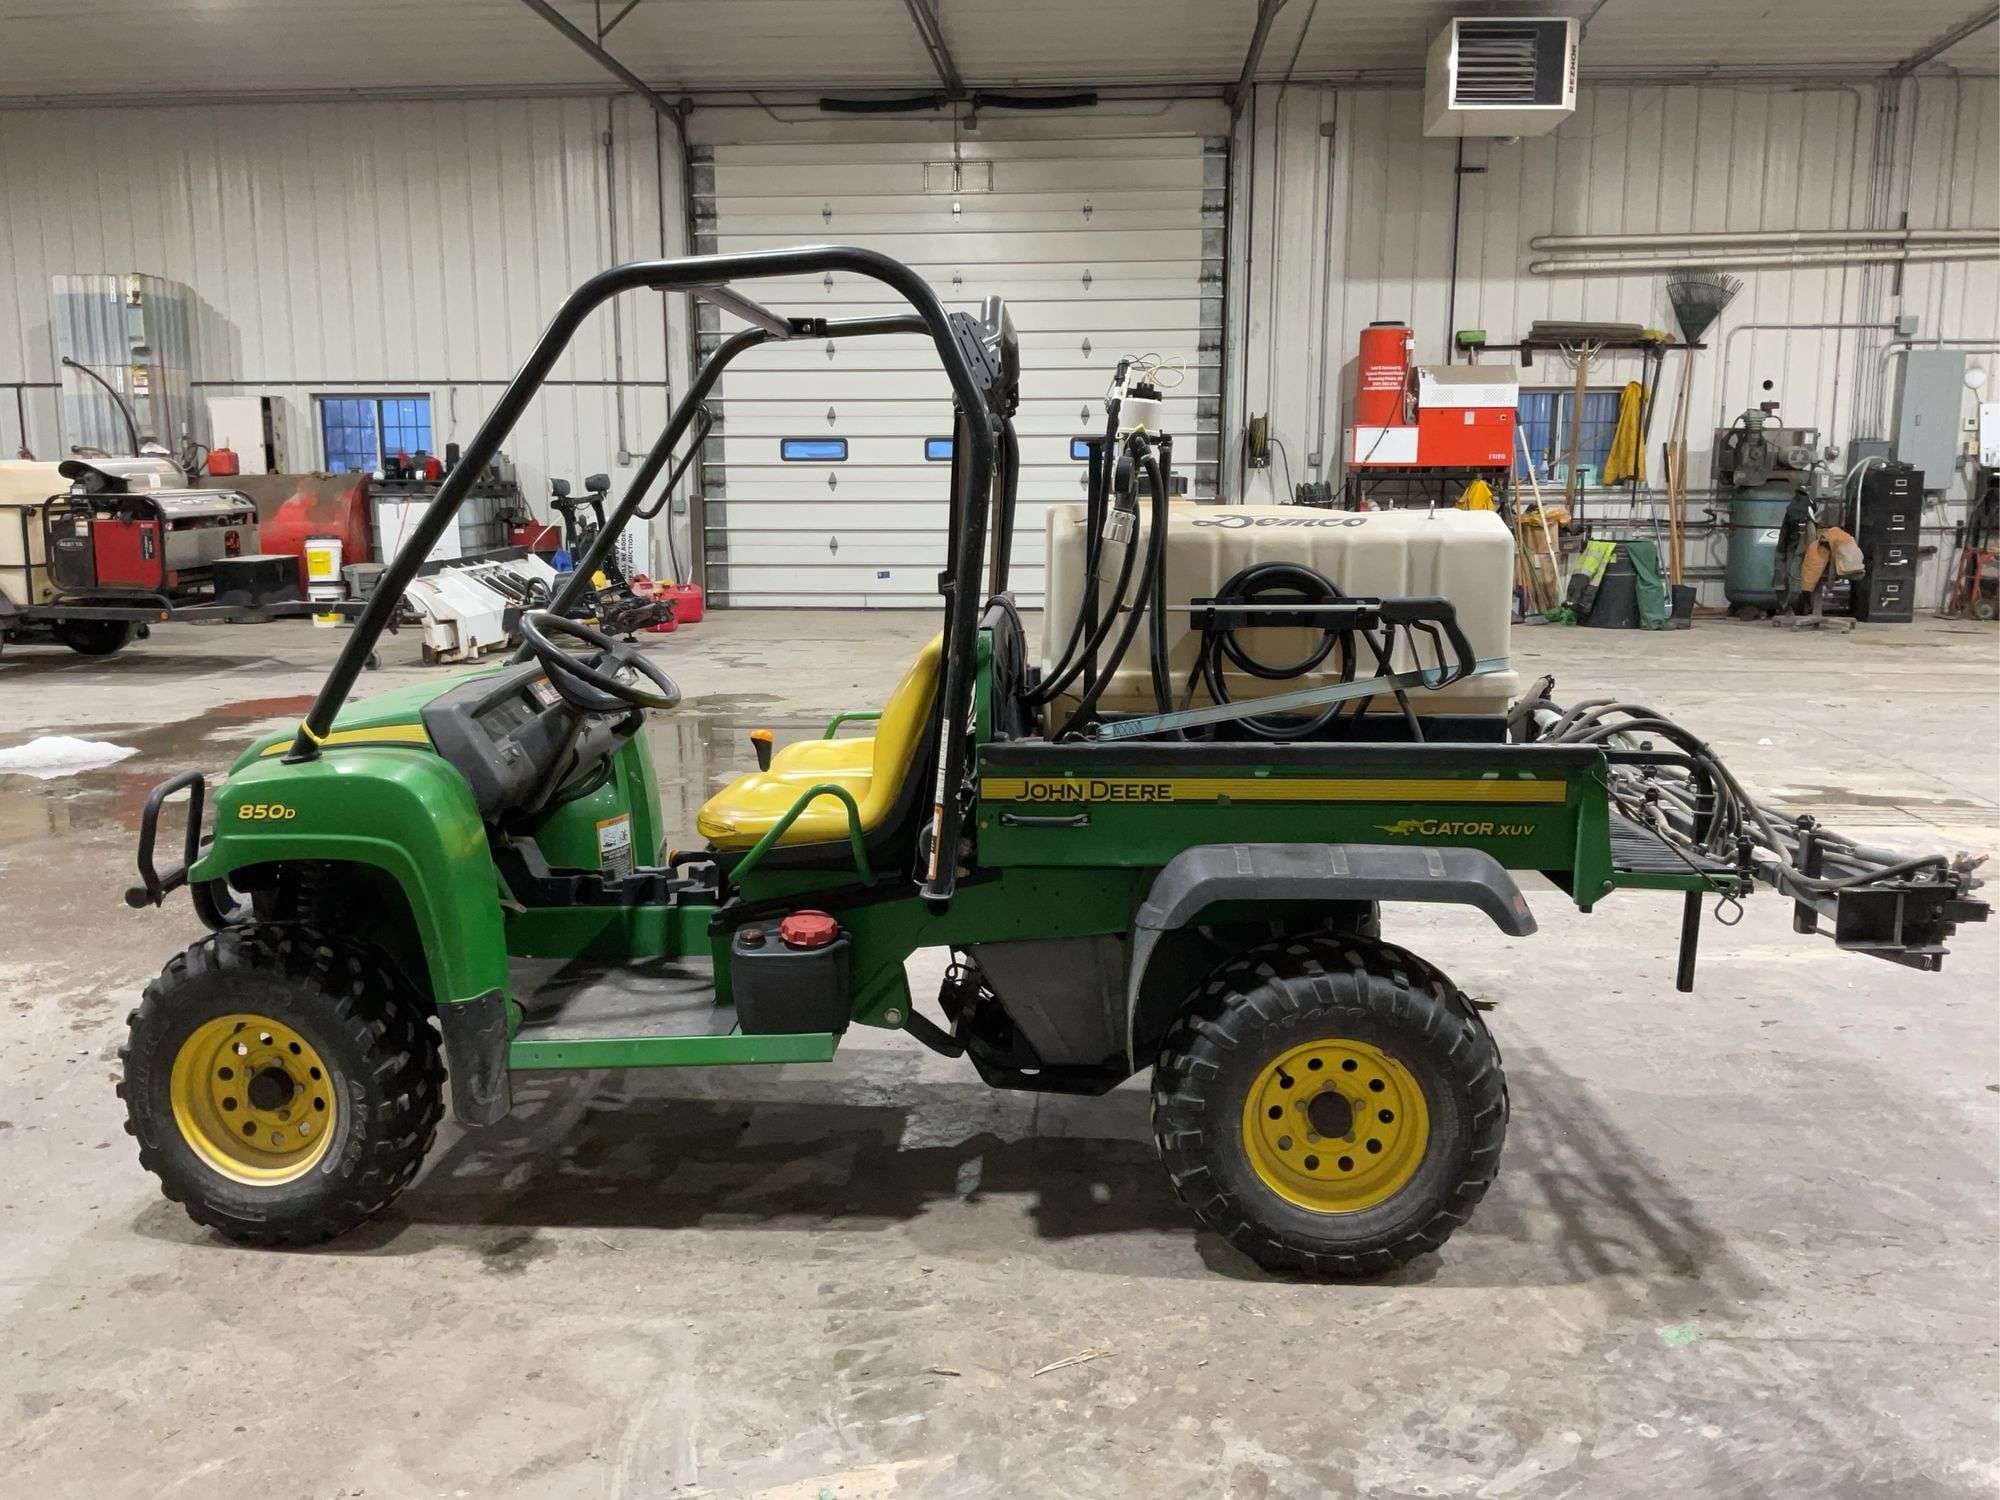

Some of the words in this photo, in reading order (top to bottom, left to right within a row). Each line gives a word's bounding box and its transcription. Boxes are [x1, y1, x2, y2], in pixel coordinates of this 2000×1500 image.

[1568, 44, 1577, 94] REZNOR
[1191, 514, 1368, 529] Demco
[1016, 780, 1083, 800] JOHN
[1090, 780, 1173, 800] DEERE
[238, 804, 296, 819] 850D
[1420, 819, 1495, 836] GATOR
[1498, 824, 1535, 836] XUV
